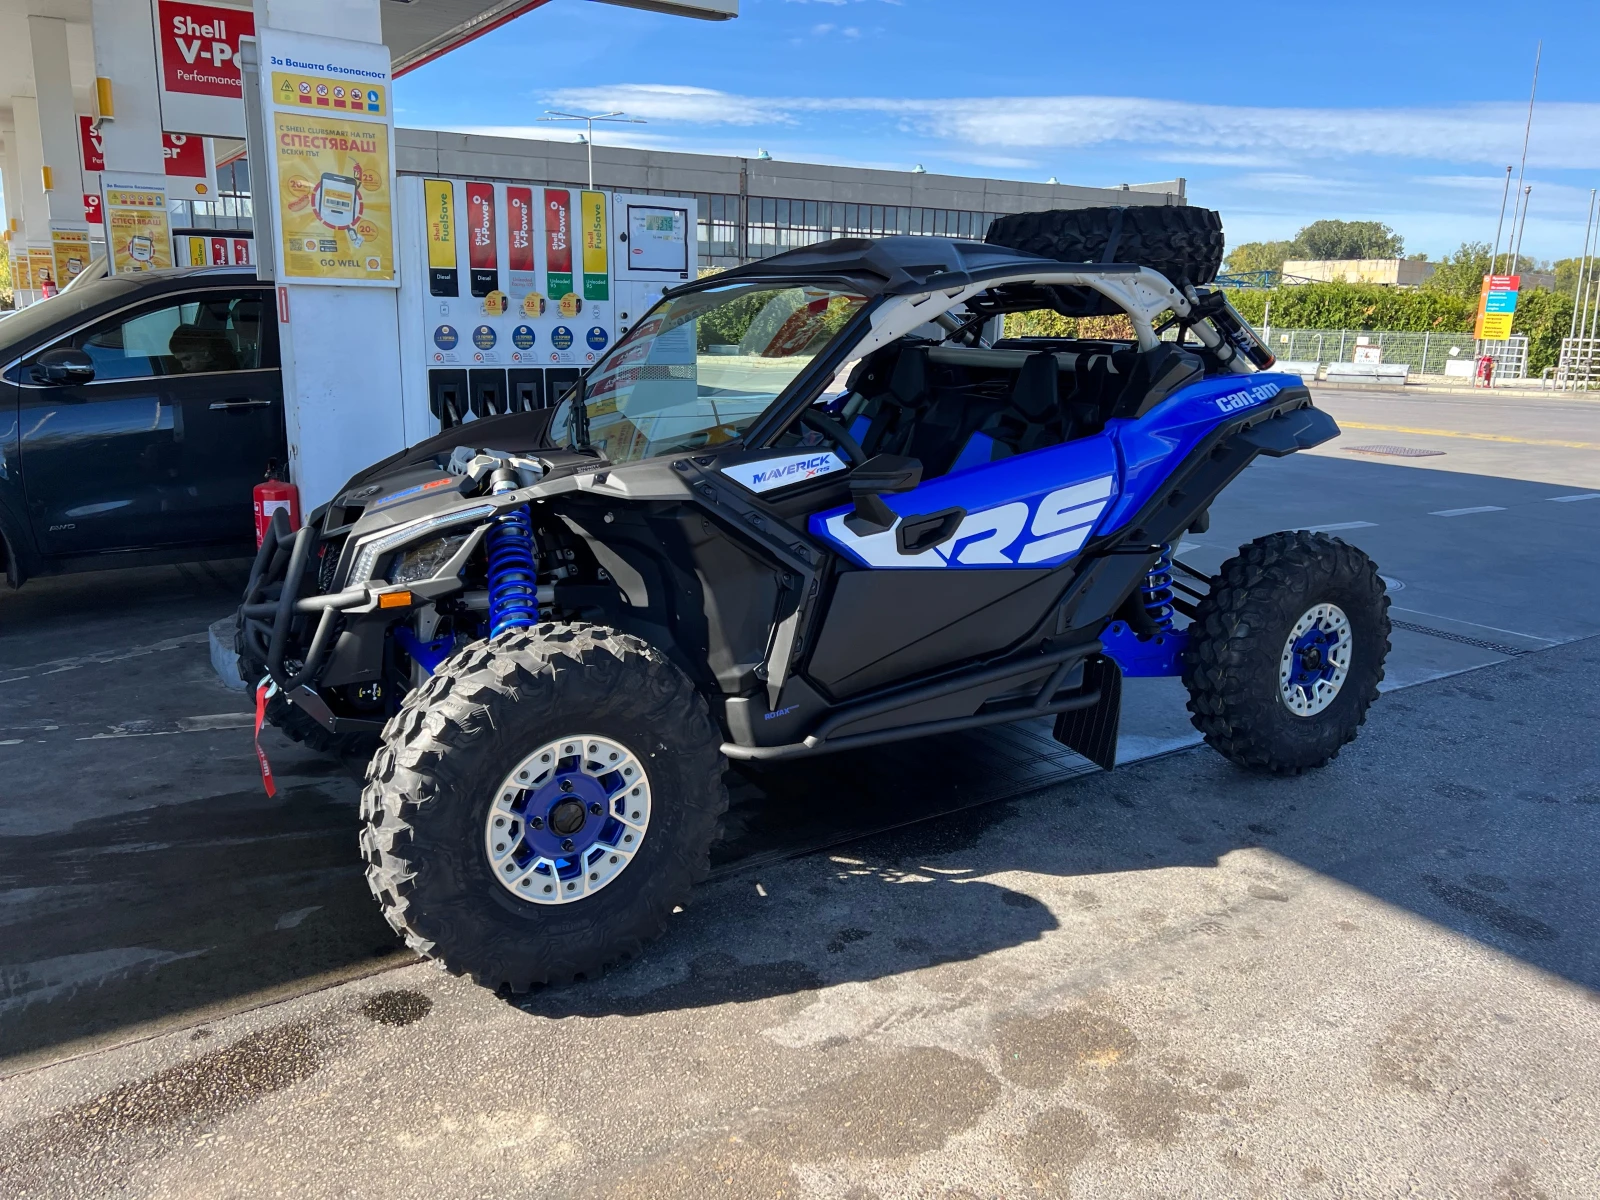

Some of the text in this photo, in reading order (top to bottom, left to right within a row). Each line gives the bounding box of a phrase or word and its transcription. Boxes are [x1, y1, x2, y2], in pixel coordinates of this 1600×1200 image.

[173, 16, 226, 40] Shell
[177, 70, 242, 86] Performance
[270, 57, 385, 79] За Вашата безопасност
[281, 134, 376, 153] СПЕСТЯВАШ
[308, 128, 349, 136] CLUBSMART
[440, 193, 449, 242] FuelSave
[482, 200, 490, 245] V-Power
[520, 203, 528, 248] V-Power
[558, 206, 566, 250] V-Power
[594, 204, 602, 249] FuelSave
[1216, 382, 1280, 412] can-am
[753, 454, 830, 484] MAVERICK
[764, 708, 789, 720] ROTAX
